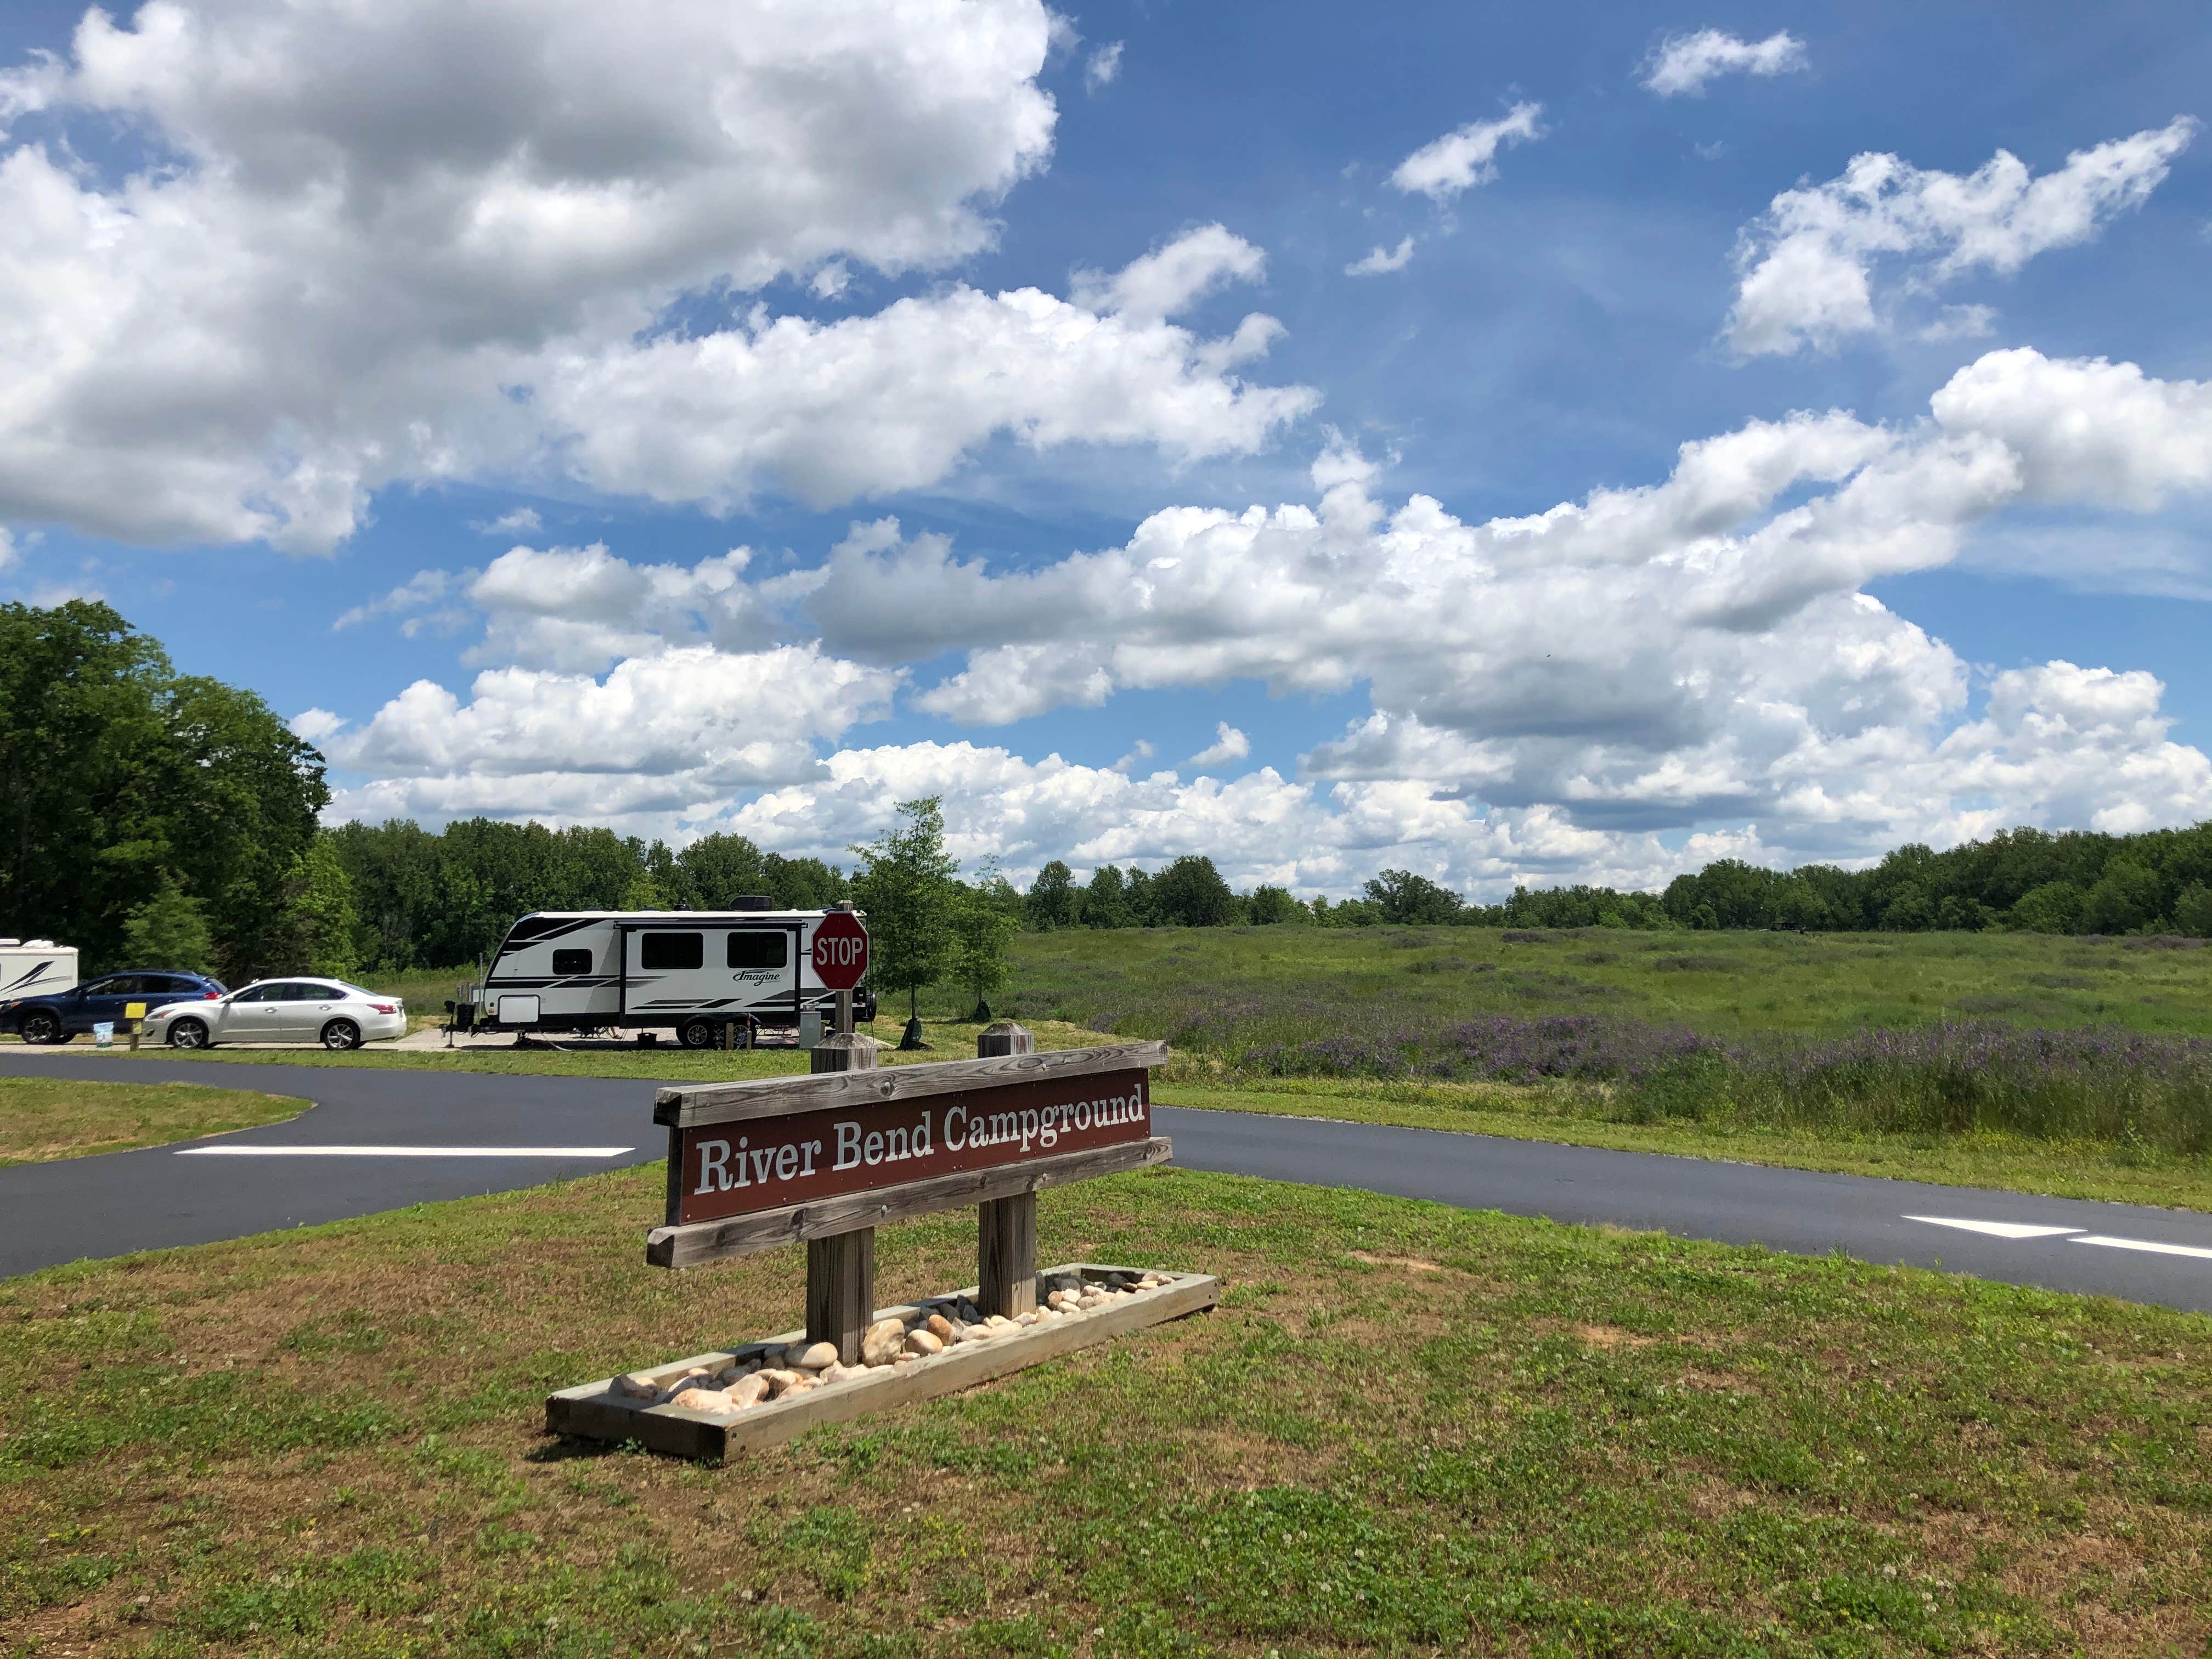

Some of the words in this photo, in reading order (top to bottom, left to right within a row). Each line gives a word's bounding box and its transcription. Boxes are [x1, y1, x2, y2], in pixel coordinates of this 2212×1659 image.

[816, 937, 864, 966] STOP
[733, 970, 780, 986] Imagine
[694, 1136, 822, 1195] River
[832, 1110, 934, 1172] Bend
[944, 1084, 1146, 1152] Campground
